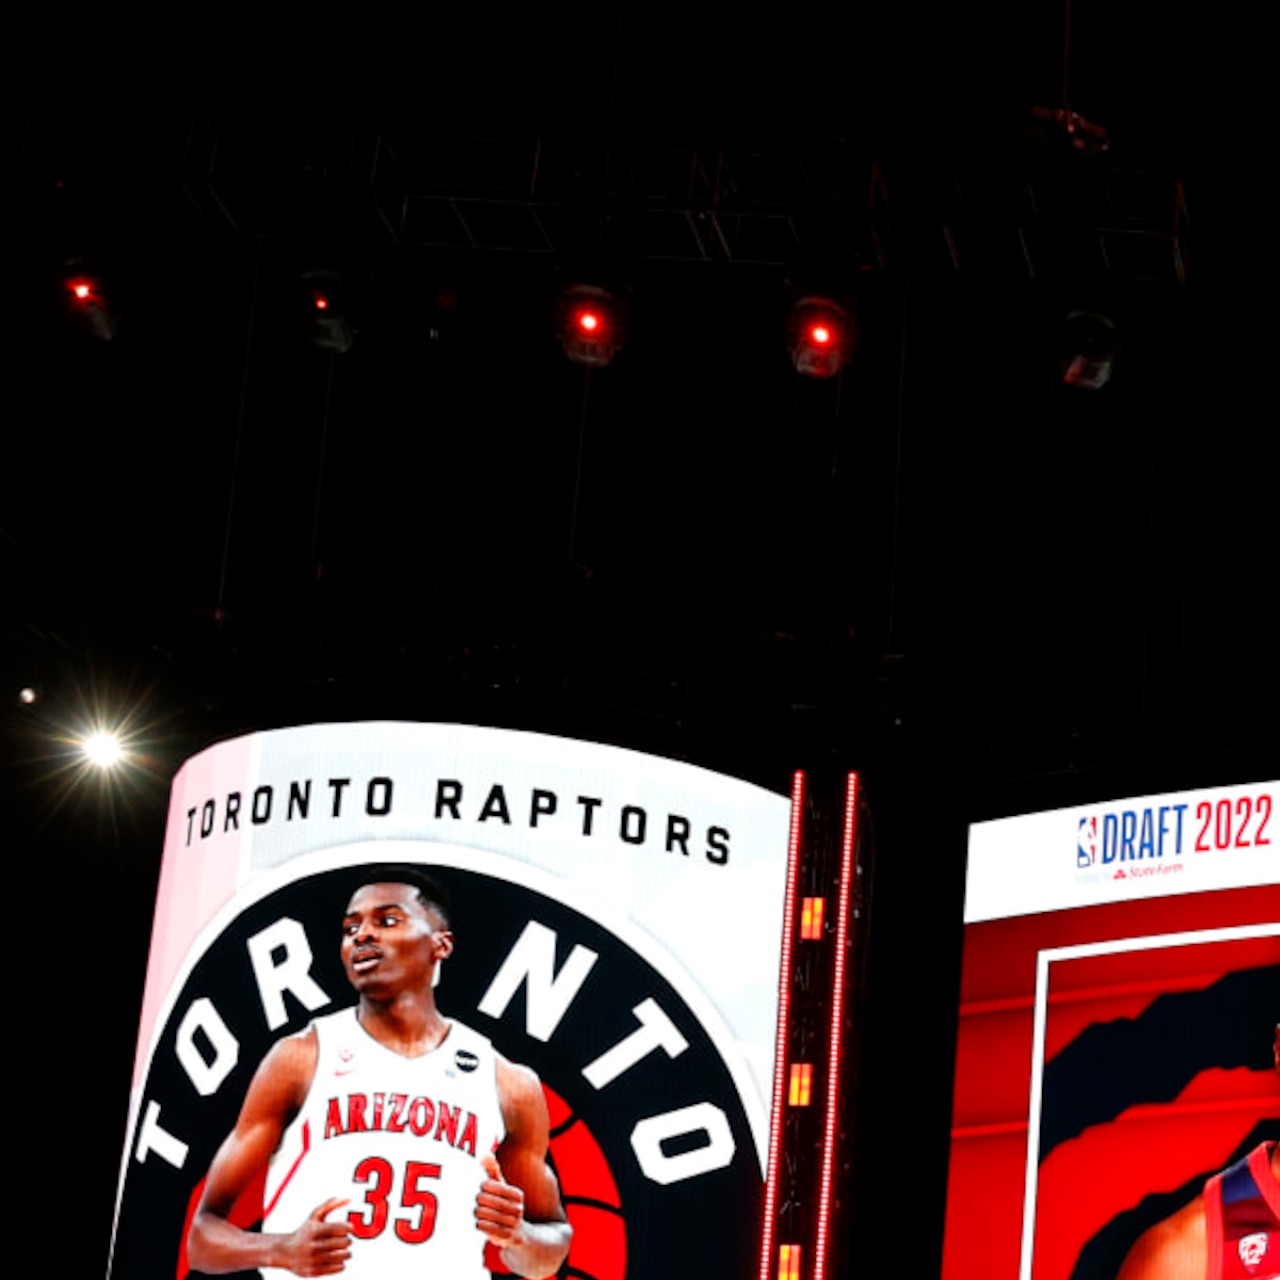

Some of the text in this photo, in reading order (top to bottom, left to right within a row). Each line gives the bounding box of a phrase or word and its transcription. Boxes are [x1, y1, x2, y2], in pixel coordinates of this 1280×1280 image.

[185, 776, 733, 867] TORONTO RAPTORS
[1101, 794, 1272, 864] DRAFT 2022
[135, 917, 736, 1186] TORNTO
[323, 1091, 479, 1158] ARIZONA
[347, 1155, 442, 1245] 35
